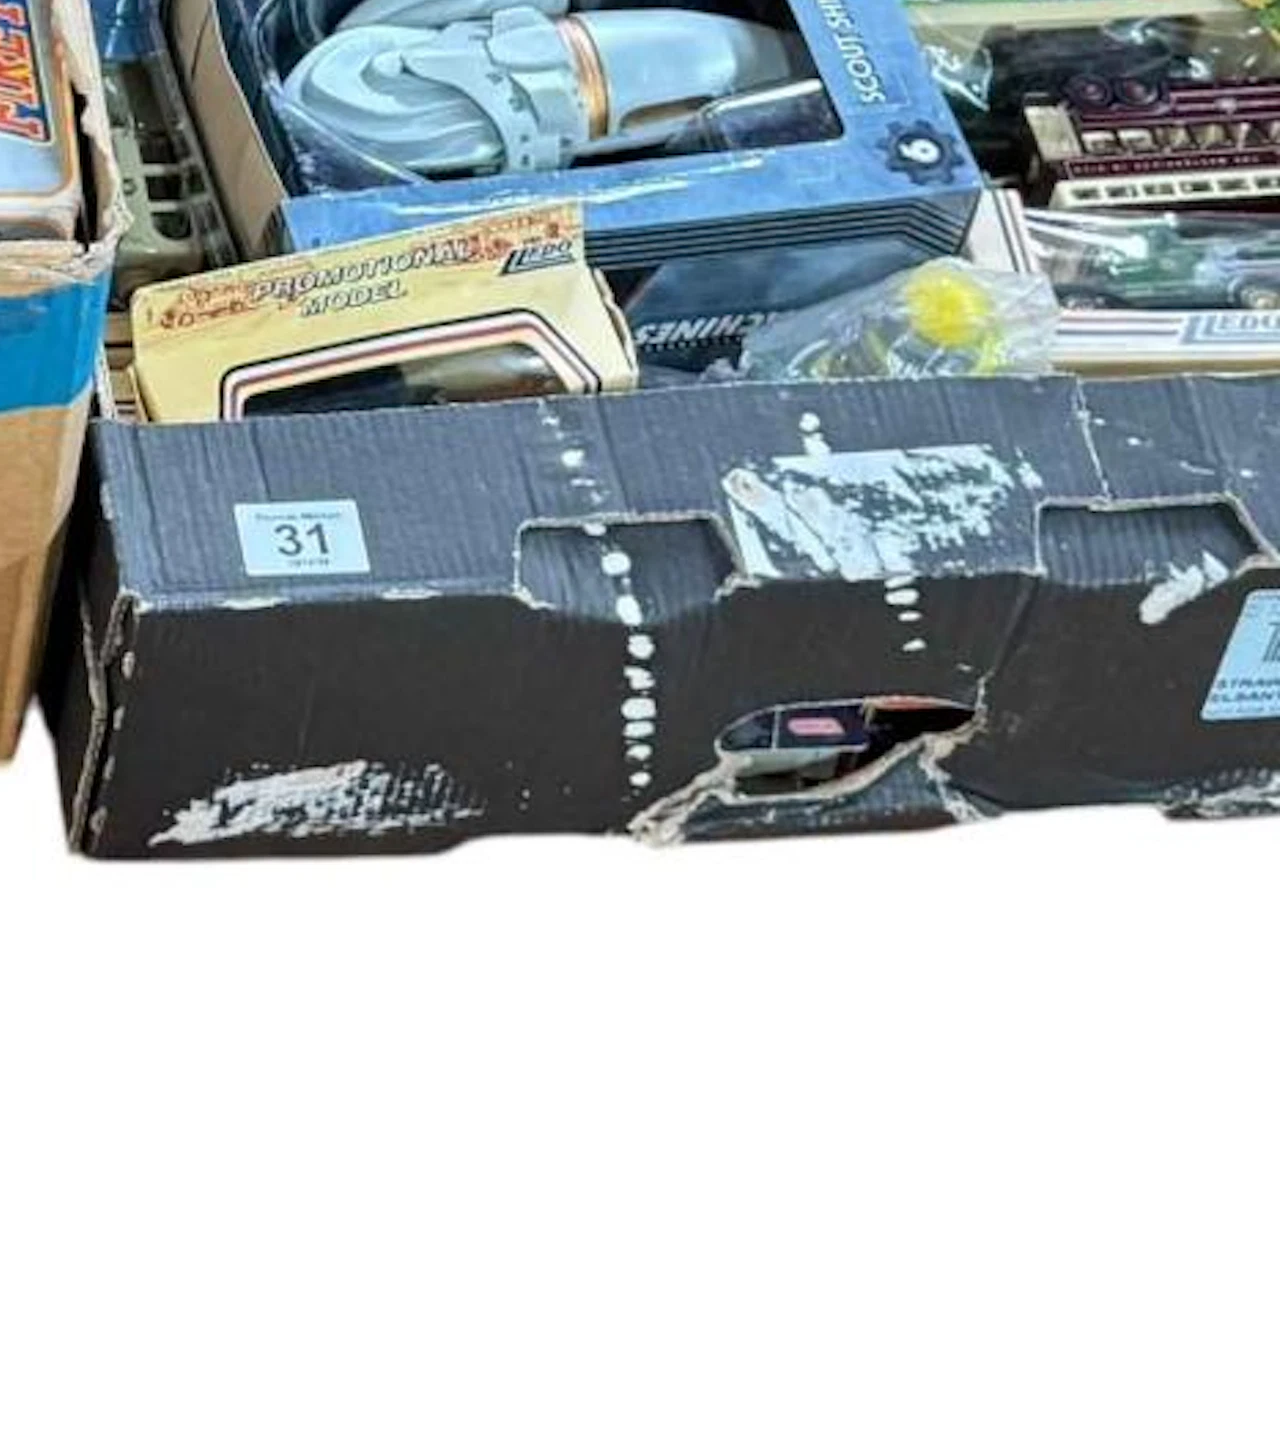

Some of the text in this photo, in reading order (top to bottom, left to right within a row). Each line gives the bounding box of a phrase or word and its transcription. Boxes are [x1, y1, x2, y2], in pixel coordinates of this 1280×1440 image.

[838, 38, 885, 104] SCOUT
[253, 239, 469, 300] PROMOTIONAL
[301, 278, 407, 318] MODEL
[273, 522, 329, 557] 31
